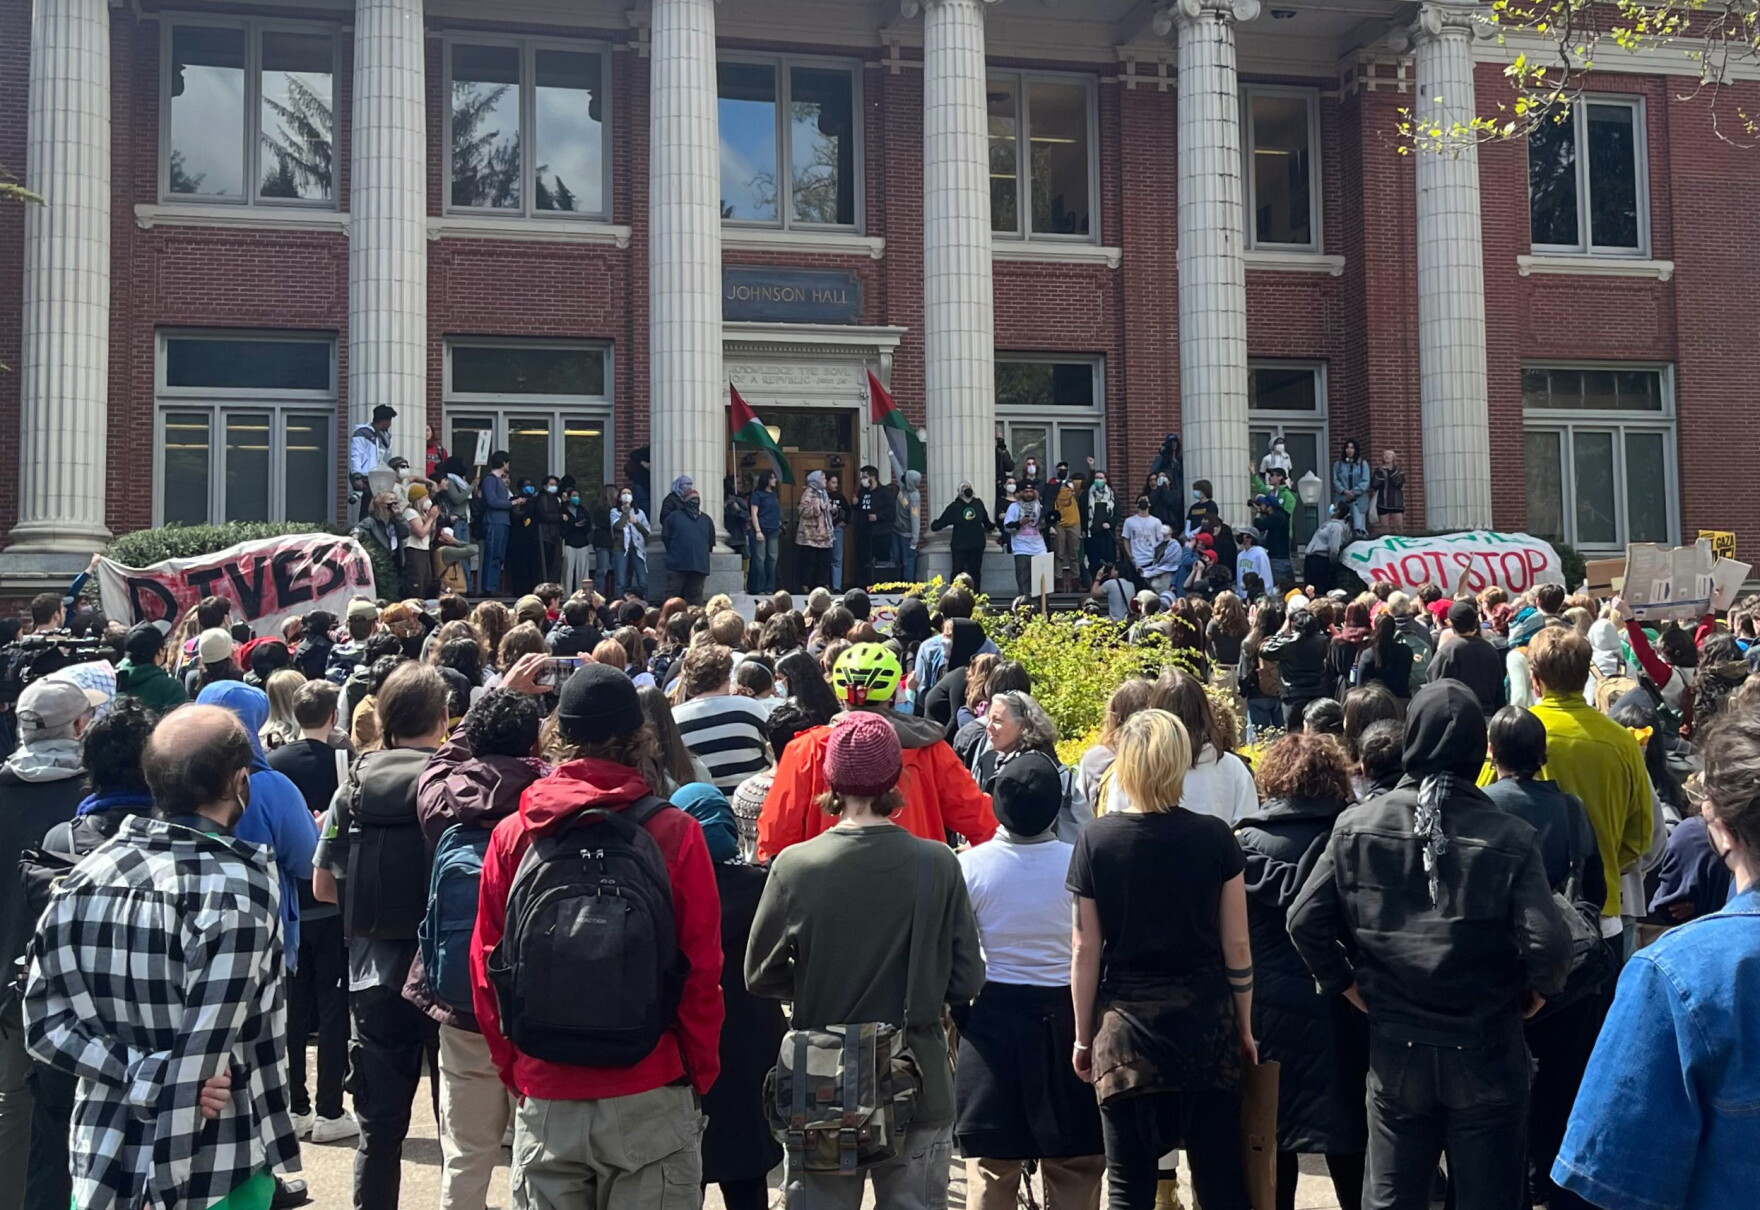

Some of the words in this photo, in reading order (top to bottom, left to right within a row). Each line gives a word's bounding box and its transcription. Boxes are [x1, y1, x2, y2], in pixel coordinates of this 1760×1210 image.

[727, 285, 805, 302] JOHNSON
[812, 289, 848, 304] HALL
[1350, 537, 1433, 563] WE
[1716, 535, 1734, 549] GAZA
[1369, 551, 1448, 590] NOT
[1452, 549, 1548, 593] STOP
